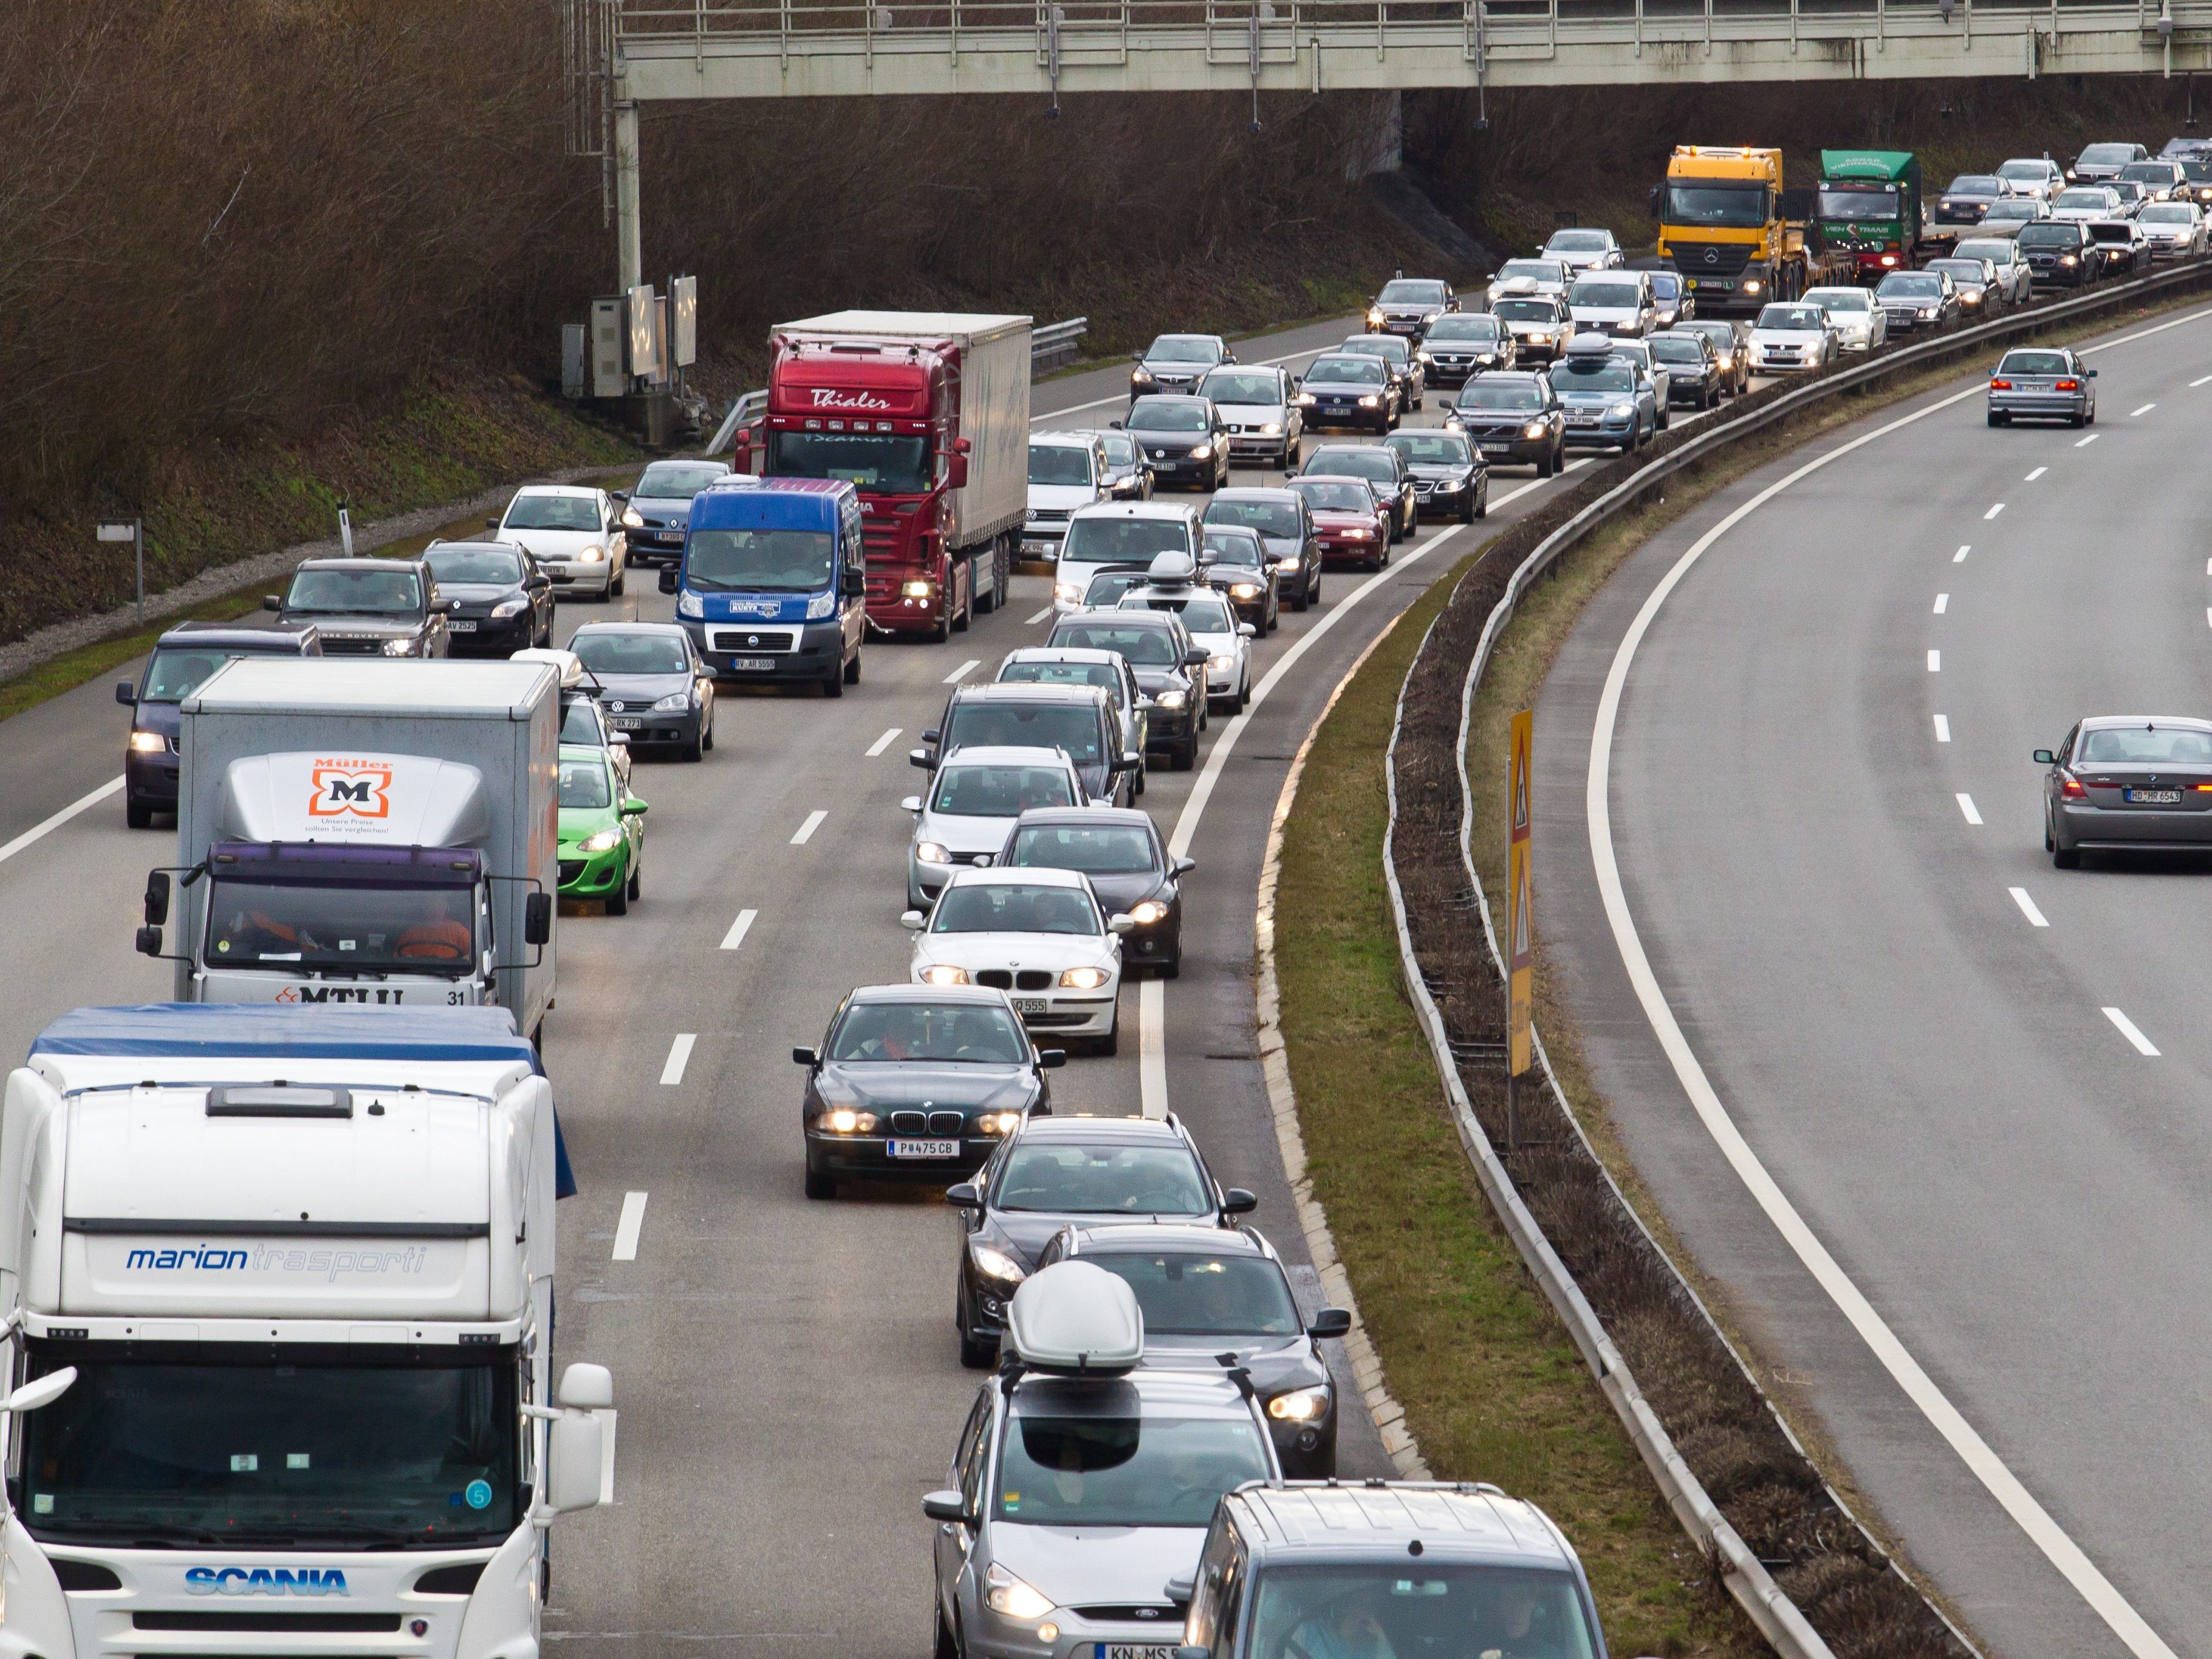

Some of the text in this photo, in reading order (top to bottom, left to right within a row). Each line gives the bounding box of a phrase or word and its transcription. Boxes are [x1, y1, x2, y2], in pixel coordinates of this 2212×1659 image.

[810, 389, 891, 409] Thialer
[314, 758, 394, 769] Müller
[328, 781, 372, 802] M
[2160, 792, 2179, 801] 6543
[447, 991, 465, 1006] 31
[1025, 1001, 1044, 1011] 555
[900, 1143, 952, 1154] P 475 CB
[126, 1242, 428, 1283] marion trasporti
[474, 1490, 485, 1504] 5
[184, 1566, 351, 1596] SCANIA
